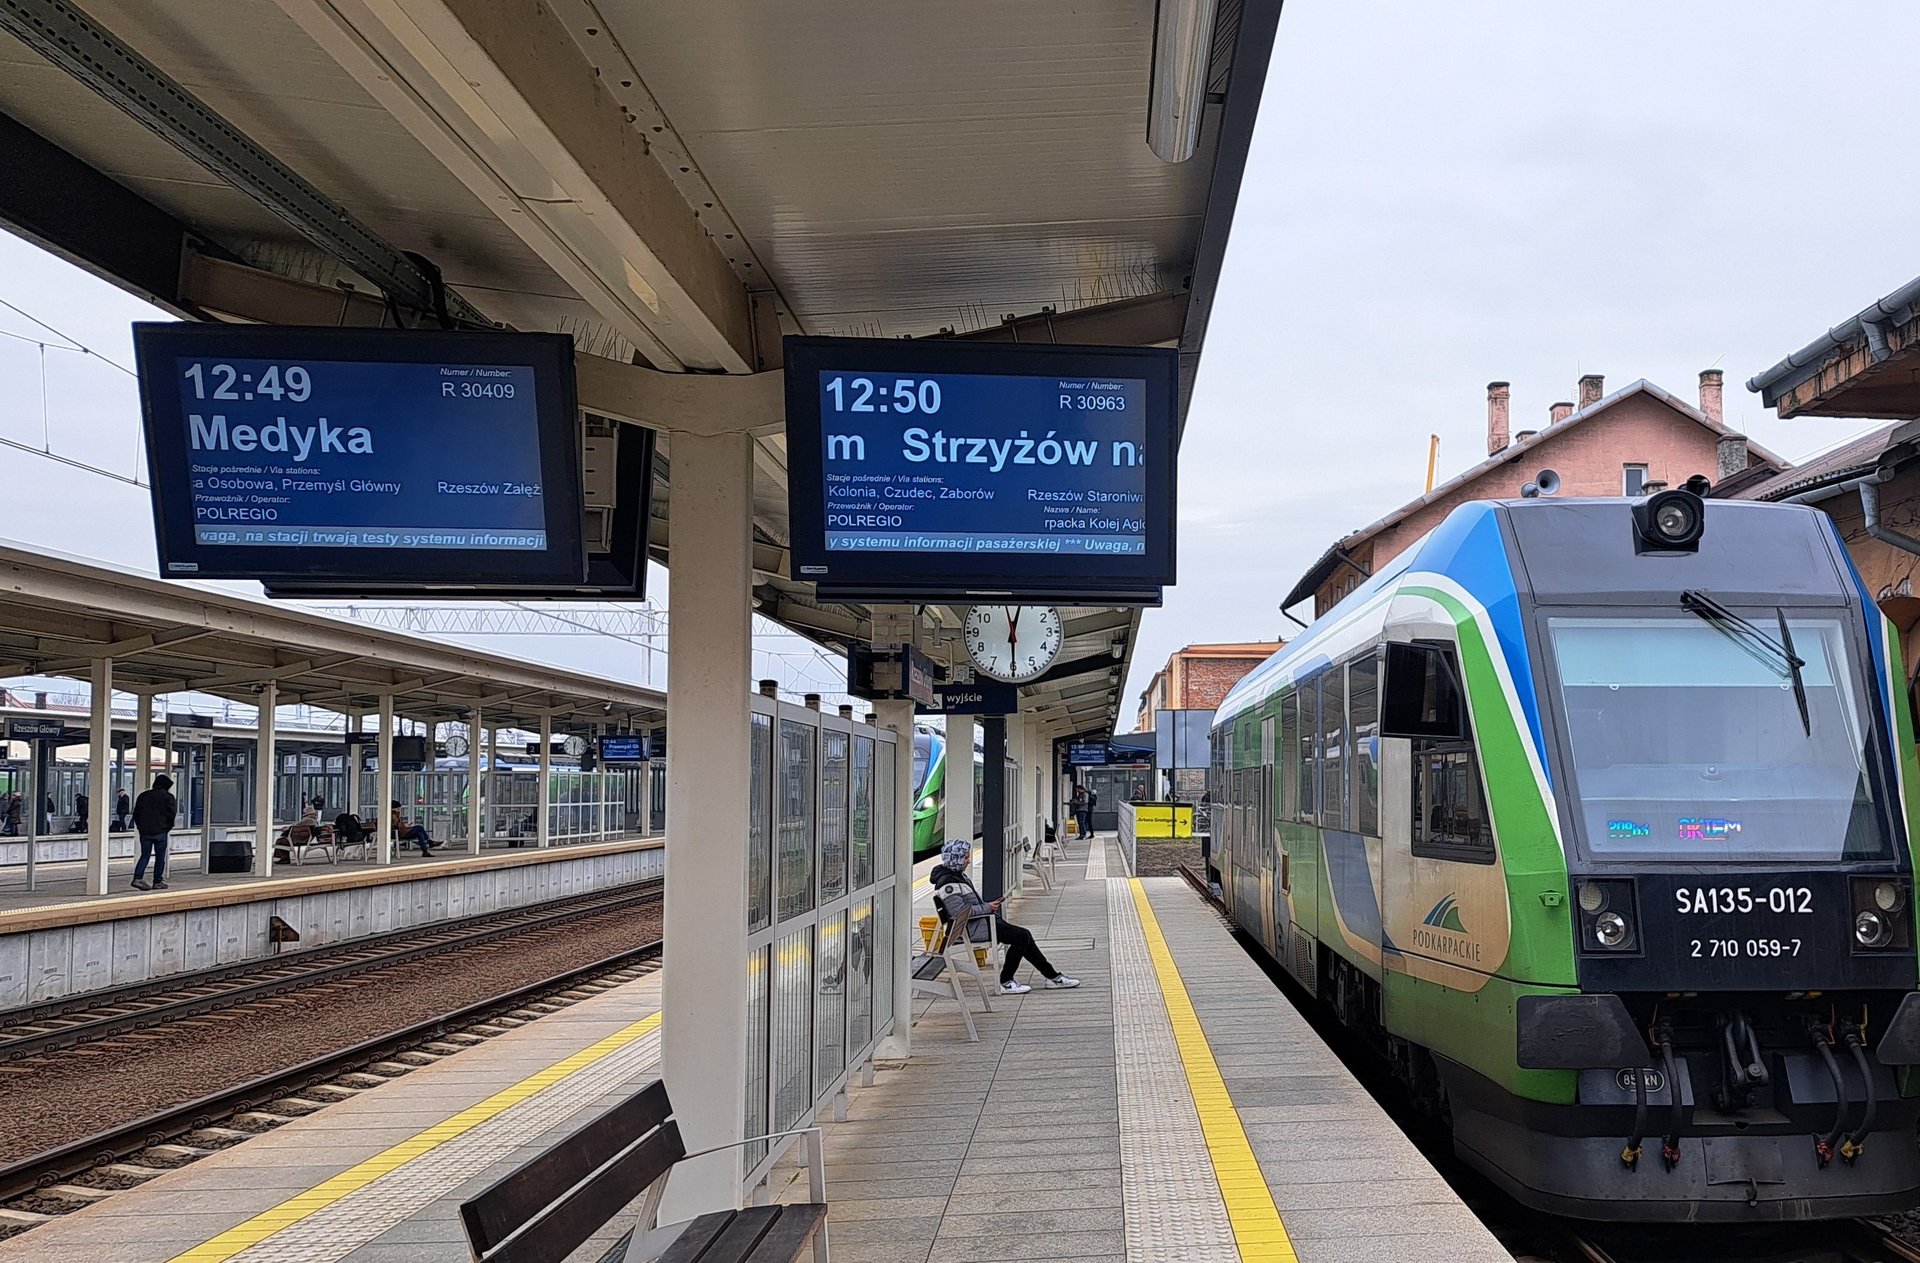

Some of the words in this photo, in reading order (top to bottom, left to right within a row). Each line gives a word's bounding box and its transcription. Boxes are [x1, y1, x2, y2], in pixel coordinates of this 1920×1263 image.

[440, 367, 469, 376] Numer
[475, 368, 512, 378] Number:
[184, 363, 312, 402] 12:49
[1059, 381, 1085, 390] Numer
[1091, 382, 1124, 391] Number:
[441, 382, 457, 397] R
[461, 382, 515, 399] 30409
[826, 377, 941, 414] 12:50
[1060, 394, 1072, 409] R
[1077, 395, 1126, 411] 30963
[189, 414, 374, 462] Medyka
[827, 432, 865, 460] m
[903, 427, 1099, 472] Strzyżów
[1112, 441, 1143, 467] n
[191, 464, 218, 475] Stacje
[219, 465, 262, 475] pośrednie
[269, 466, 283, 475] Via
[285, 467, 321, 476] stations:
[826, 473, 851, 483] Stacje
[852, 474, 891, 484] pośrednie
[898, 475, 910, 483] Via
[912, 475, 944, 484] stations:
[193, 479, 204, 489] a
[207, 476, 279, 492] Osobowa,
[282, 478, 346, 494] Przemyśl
[349, 479, 402, 495] Główny
[437, 481, 500, 495] Rzeszów
[503, 482, 541, 497] Załęż
[828, 485, 880, 499] Kolonia,
[884, 486, 936, 500] Czudec,
[939, 487, 995, 500] Zaborów
[1027, 489, 1084, 502] Rzeszów
[250, 495, 291, 505] Operator:
[878, 502, 915, 512] Operator:
[1043, 505, 1070, 514] Nazwa
[1075, 506, 1101, 515] Name:
[196, 507, 278, 521] POLREGIO
[828, 514, 902, 528] POLREGIO
[1044, 517, 1086, 532] rpacka
[1089, 518, 1120, 532] Kolej
[245, 532, 264, 542] na
[268, 530, 308, 544] stacji
[312, 532, 358, 546] trwają
[362, 533, 399, 546] testy
[403, 535, 466, 547] systemu
[469, 533, 544, 549] informacji
[829, 537, 838, 549] y
[841, 536, 900, 549] systemu
[904, 536, 973, 550] informacji
[975, 537, 1061, 552] pasażerskiej
[1084, 539, 1132, 552] Uwaga,
[977, 613, 991, 624] 10
[1040, 613, 1047, 624] 2
[972, 627, 980, 638] 9
[1046, 627, 1053, 637] 3
[977, 641, 985, 652] 8
[1040, 641, 1047, 652] 4
[990, 656, 998, 667] 7
[1009, 660, 1017, 672] 6
[1029, 656, 1036, 667] 5
[946, 692, 983, 705] wyjście
[530, 745, 536, 753] 2
[1675, 887, 1814, 914] SA135-012
[1412, 929, 1481, 962] PODKARPACKIE
[1690, 939, 1703, 958] 2
[1708, 939, 1739, 958] 710
[1746, 939, 1802, 957] 059-7
[1644, 1074, 1658, 1086] kN
